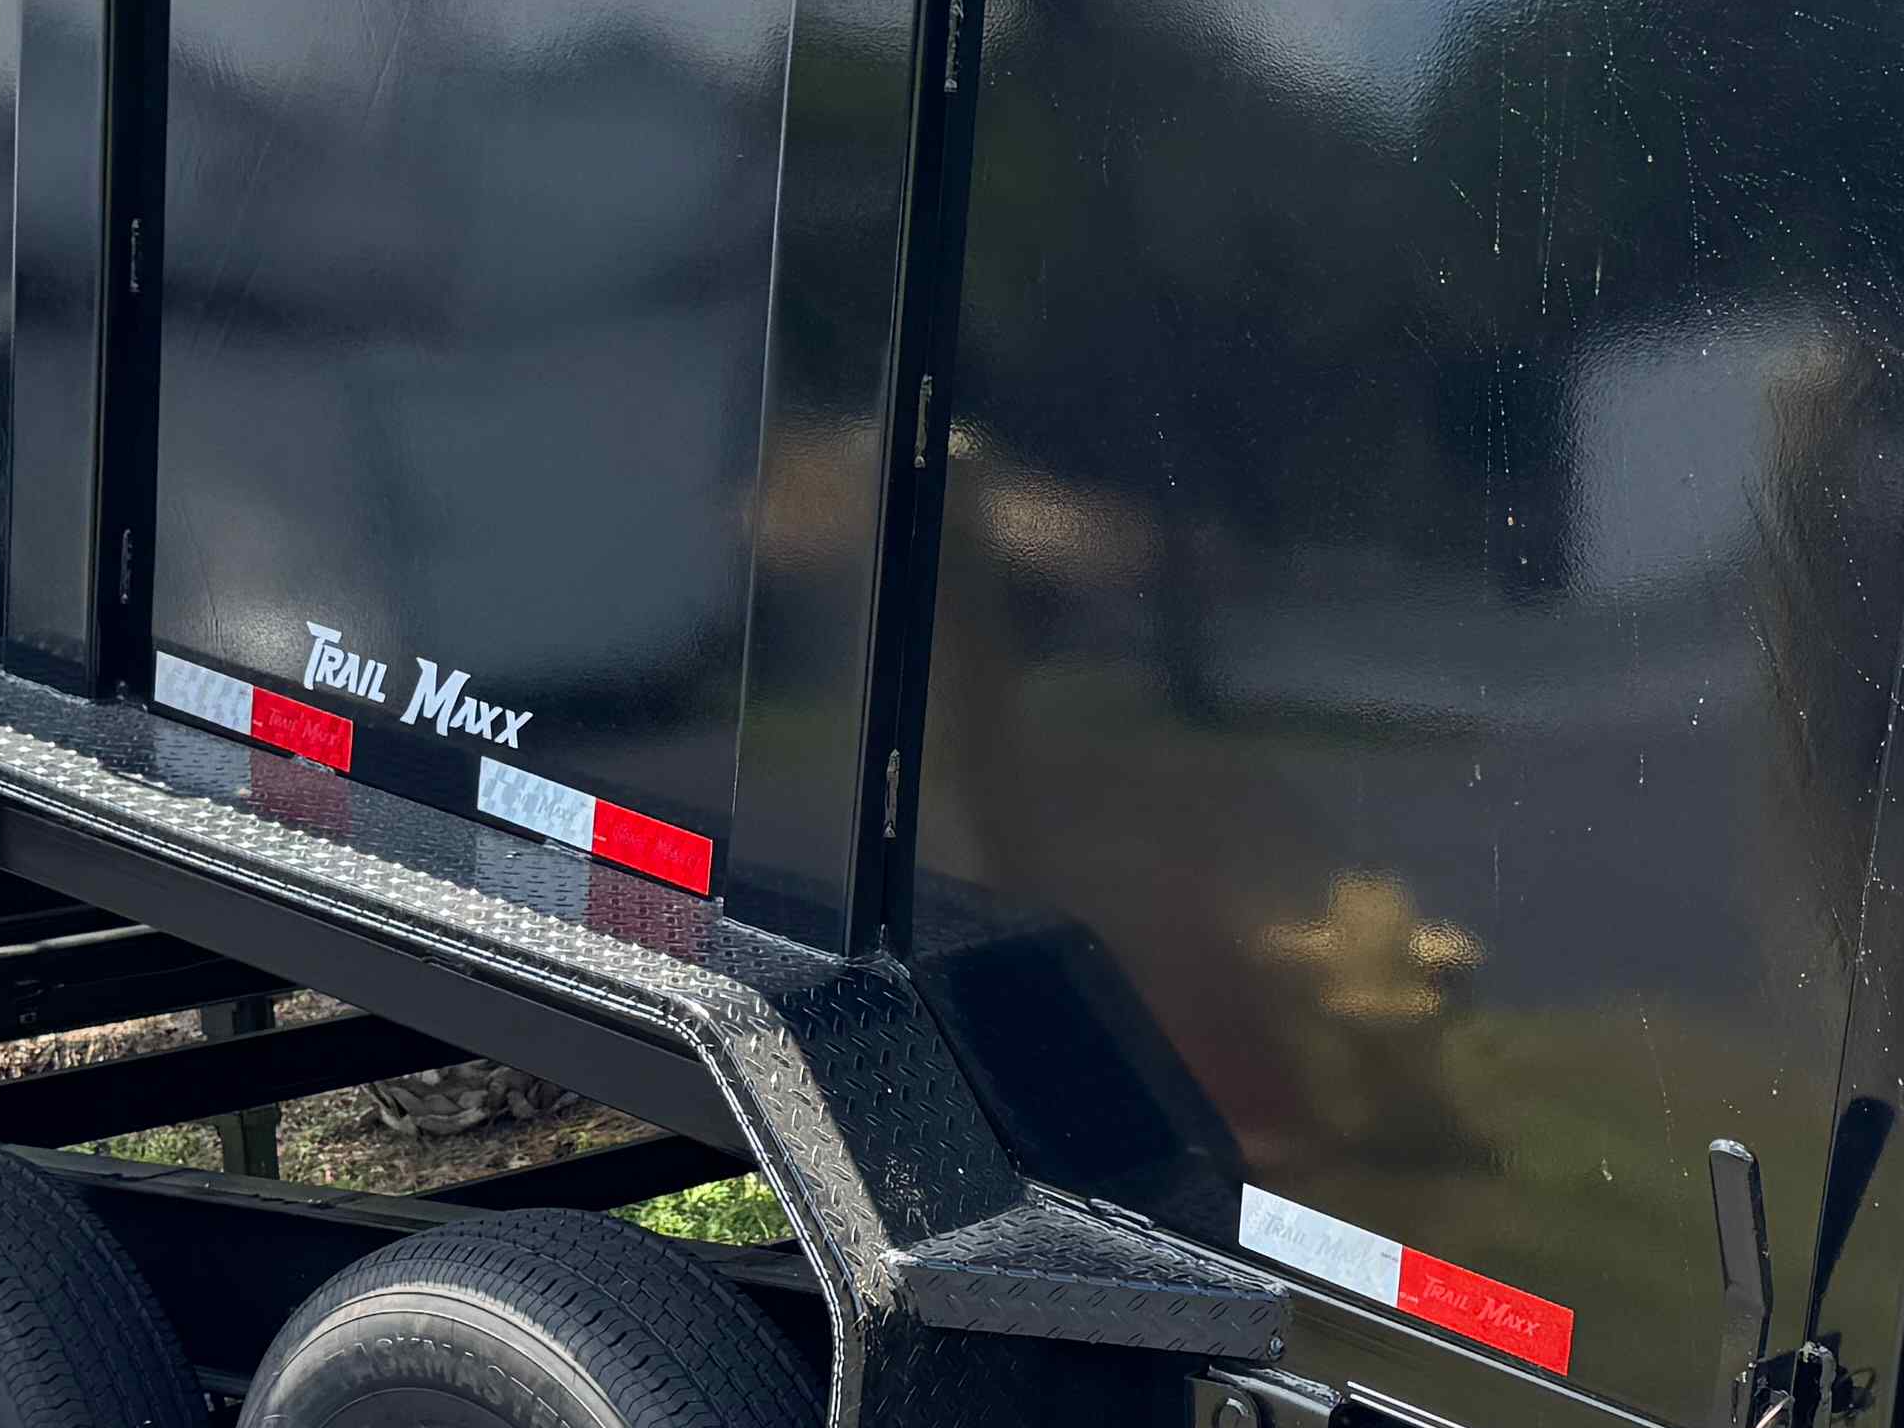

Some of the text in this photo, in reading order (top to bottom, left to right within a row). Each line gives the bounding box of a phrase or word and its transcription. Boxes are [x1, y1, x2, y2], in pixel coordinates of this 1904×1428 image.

[304, 620, 386, 703] TRAIL
[400, 657, 533, 748] MAXX
[1422, 1274, 1540, 1336] TRAIL MAXX
